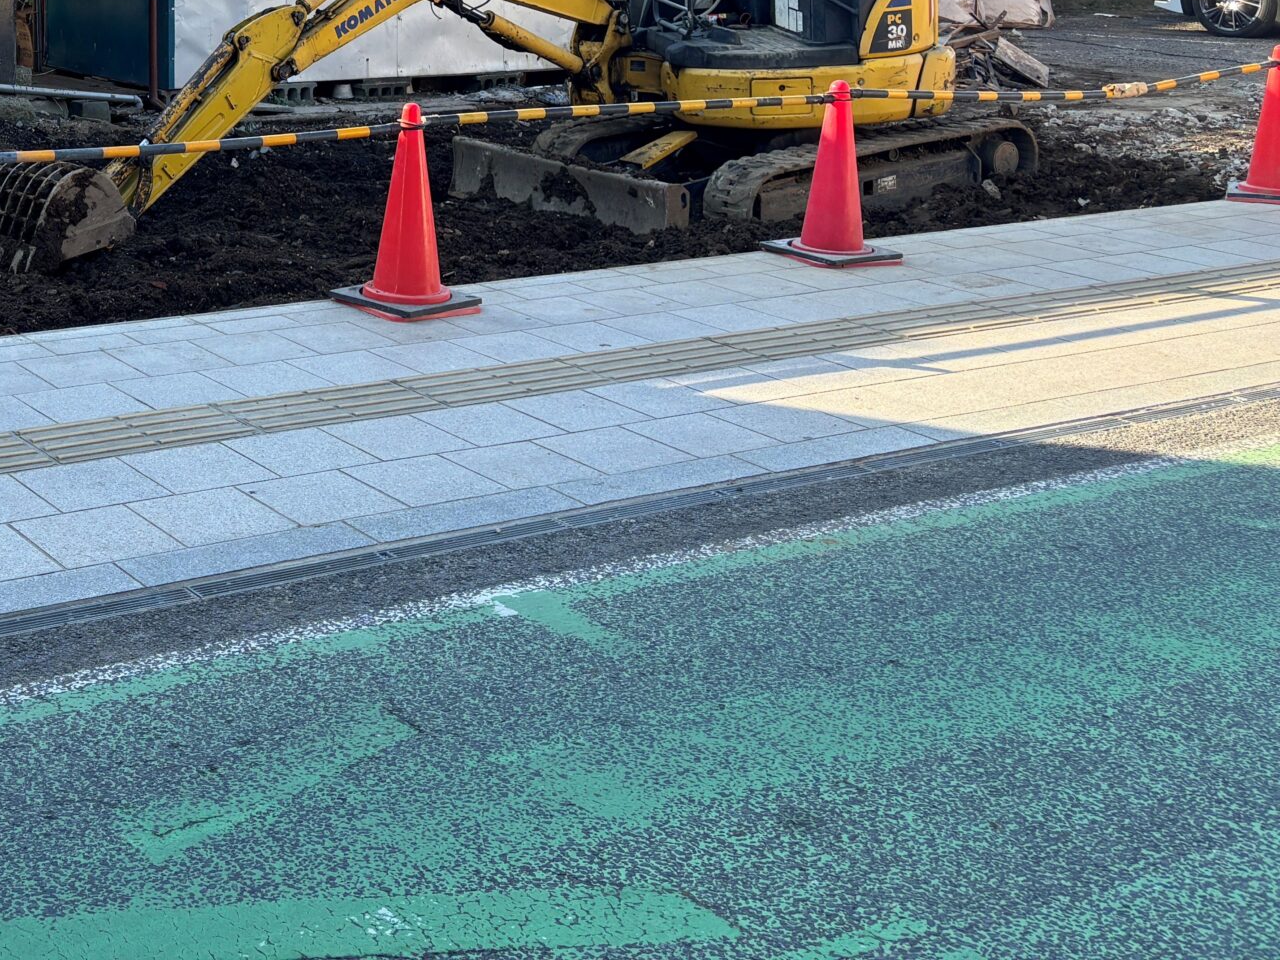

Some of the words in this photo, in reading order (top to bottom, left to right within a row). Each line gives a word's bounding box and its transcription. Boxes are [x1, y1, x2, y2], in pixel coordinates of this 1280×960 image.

[887, 13, 902, 25] PC
[887, 24, 907, 39] 30
[888, 40, 904, 49] MR
